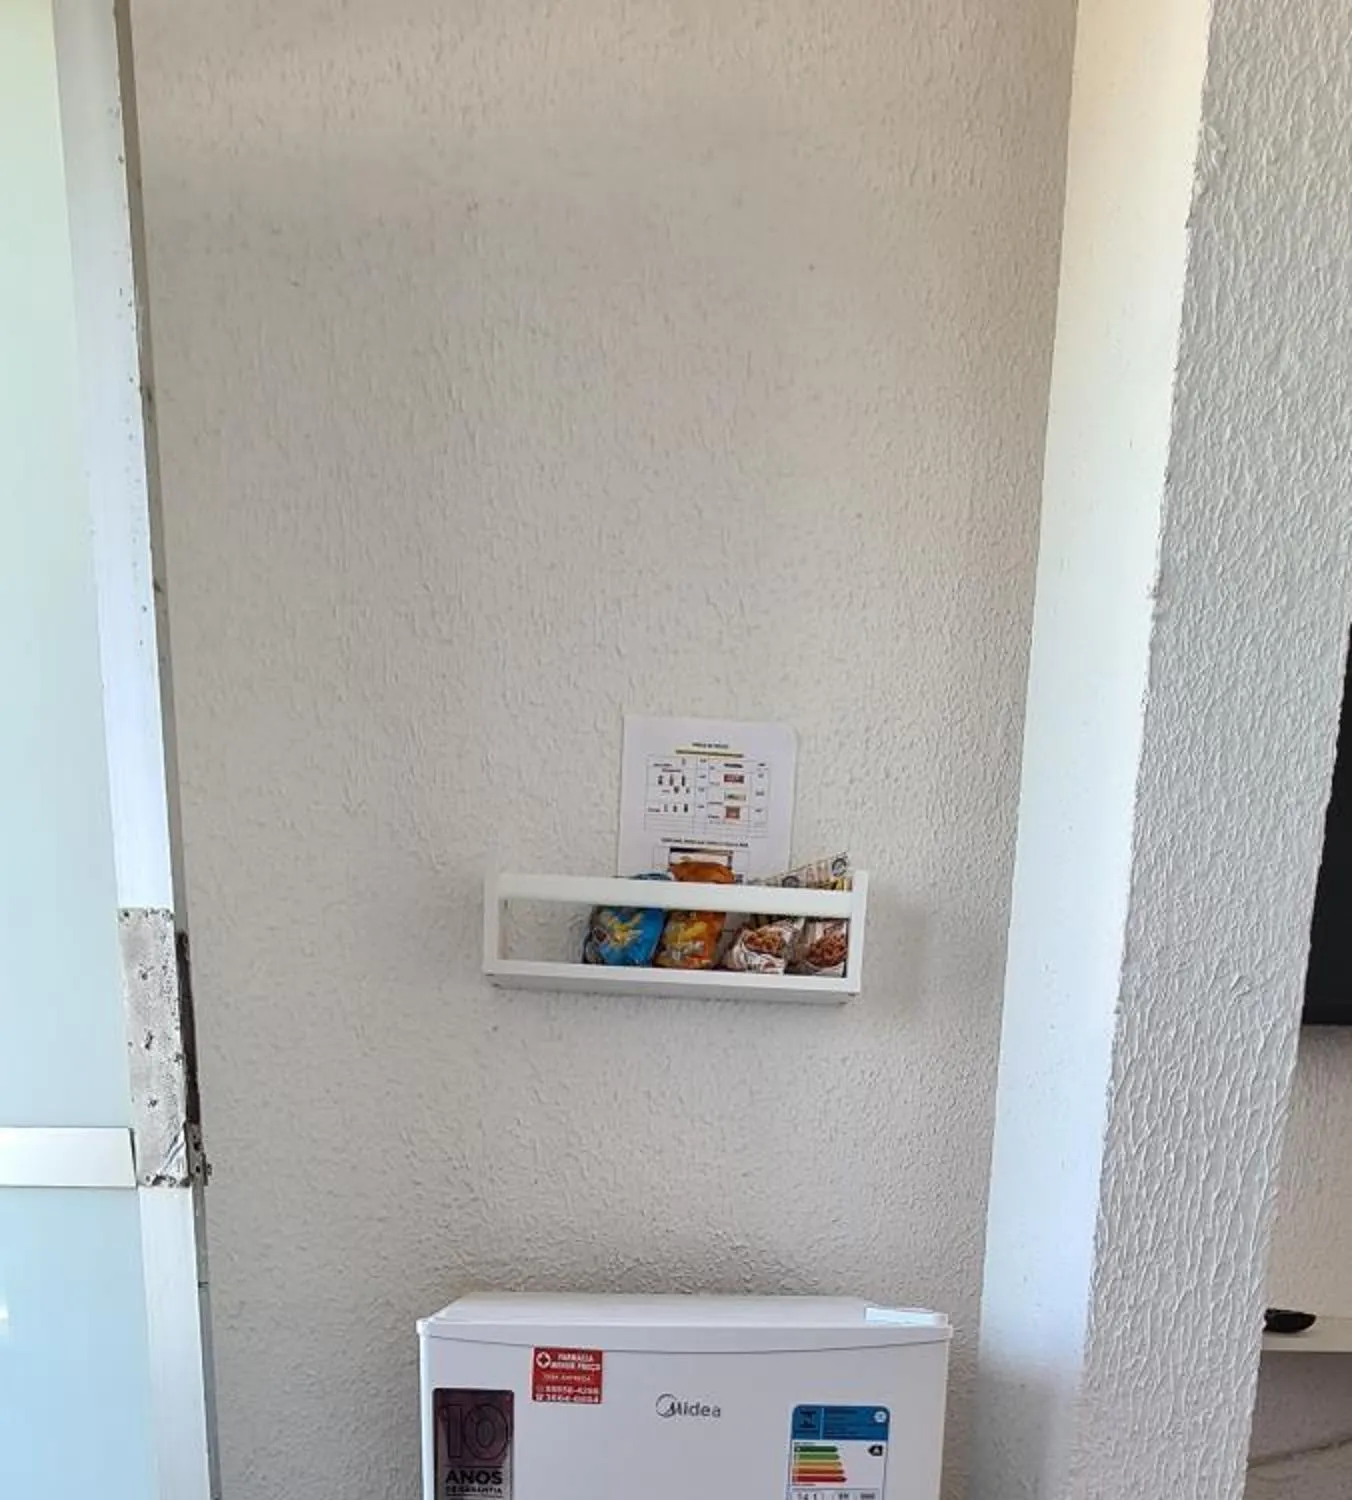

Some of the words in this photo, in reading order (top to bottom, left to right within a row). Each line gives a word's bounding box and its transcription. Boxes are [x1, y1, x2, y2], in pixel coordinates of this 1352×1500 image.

[656, 1393, 721, 1418] Midea
[438, 1403, 508, 1460] 10
[446, 1470, 503, 1485] ANOS
